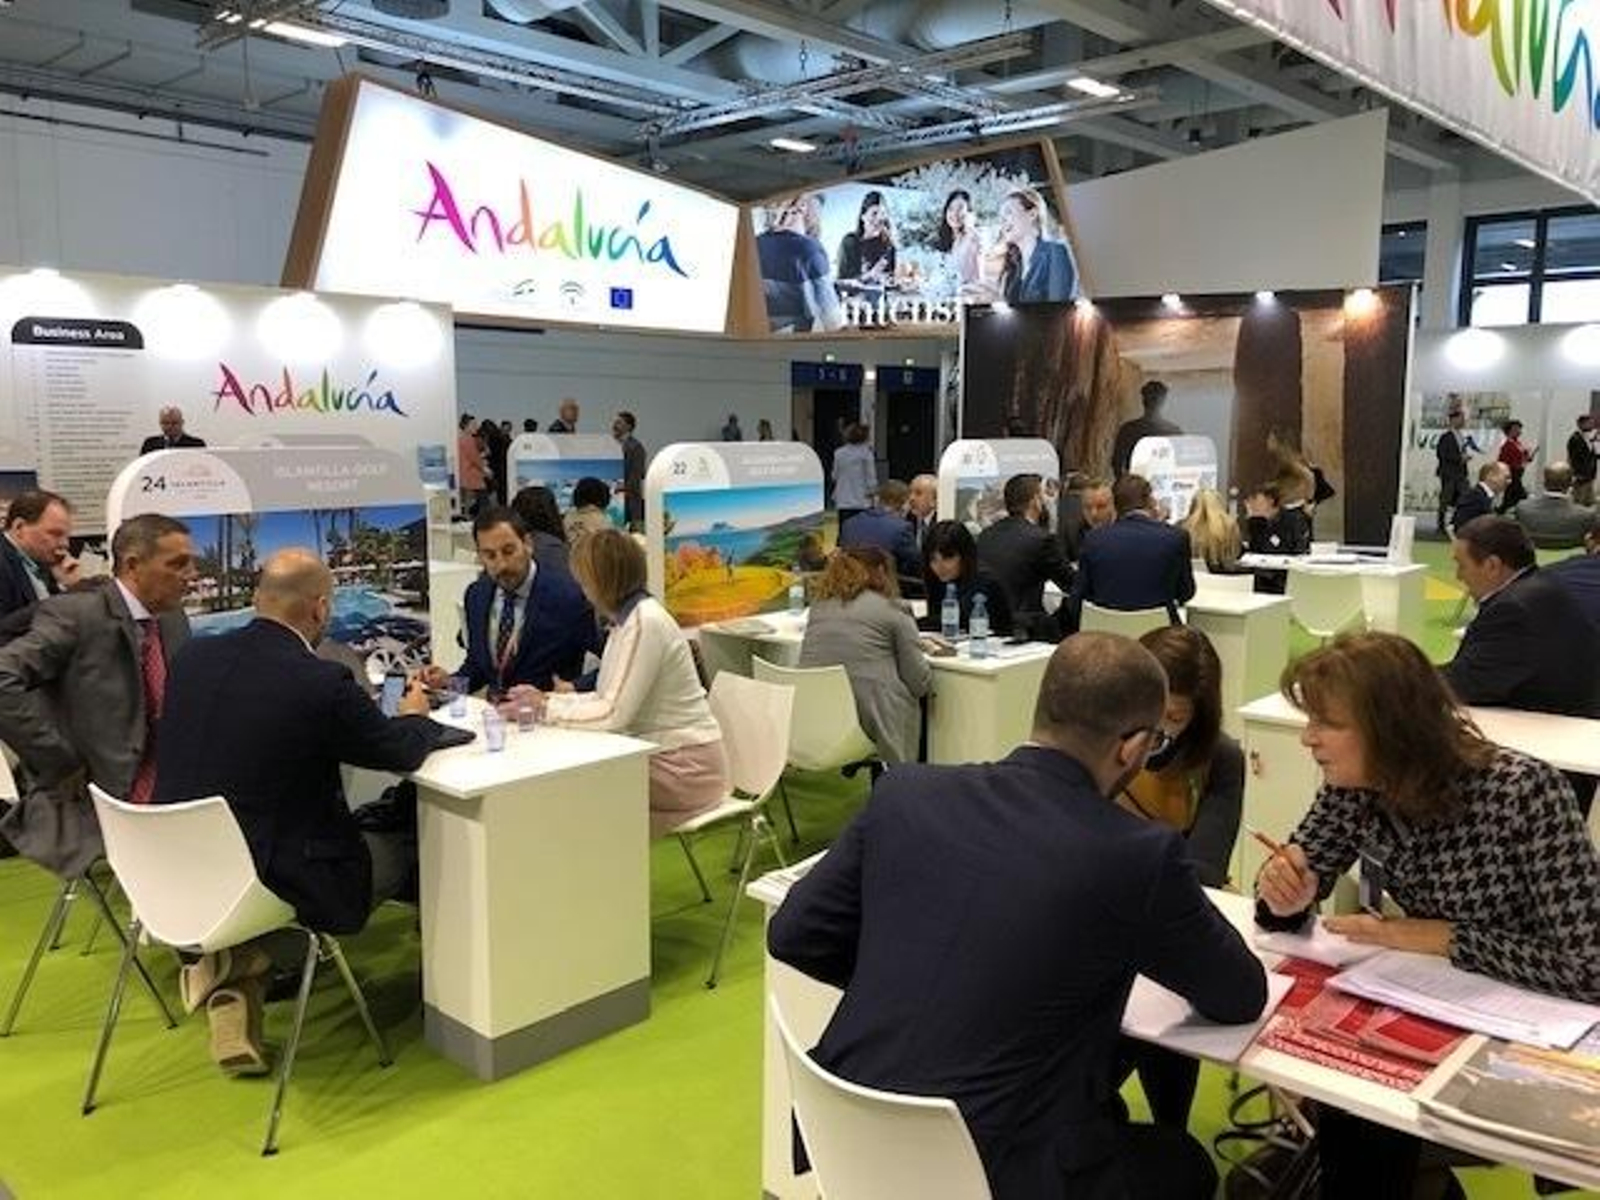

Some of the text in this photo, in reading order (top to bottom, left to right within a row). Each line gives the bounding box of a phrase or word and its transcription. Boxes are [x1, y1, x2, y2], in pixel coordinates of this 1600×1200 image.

[411, 160, 690, 278] Andalucía
[32, 325, 125, 340] Business Area
[212, 361, 409, 417] Andalucía
[672, 461, 687, 475] 22
[141, 475, 166, 492] 24
